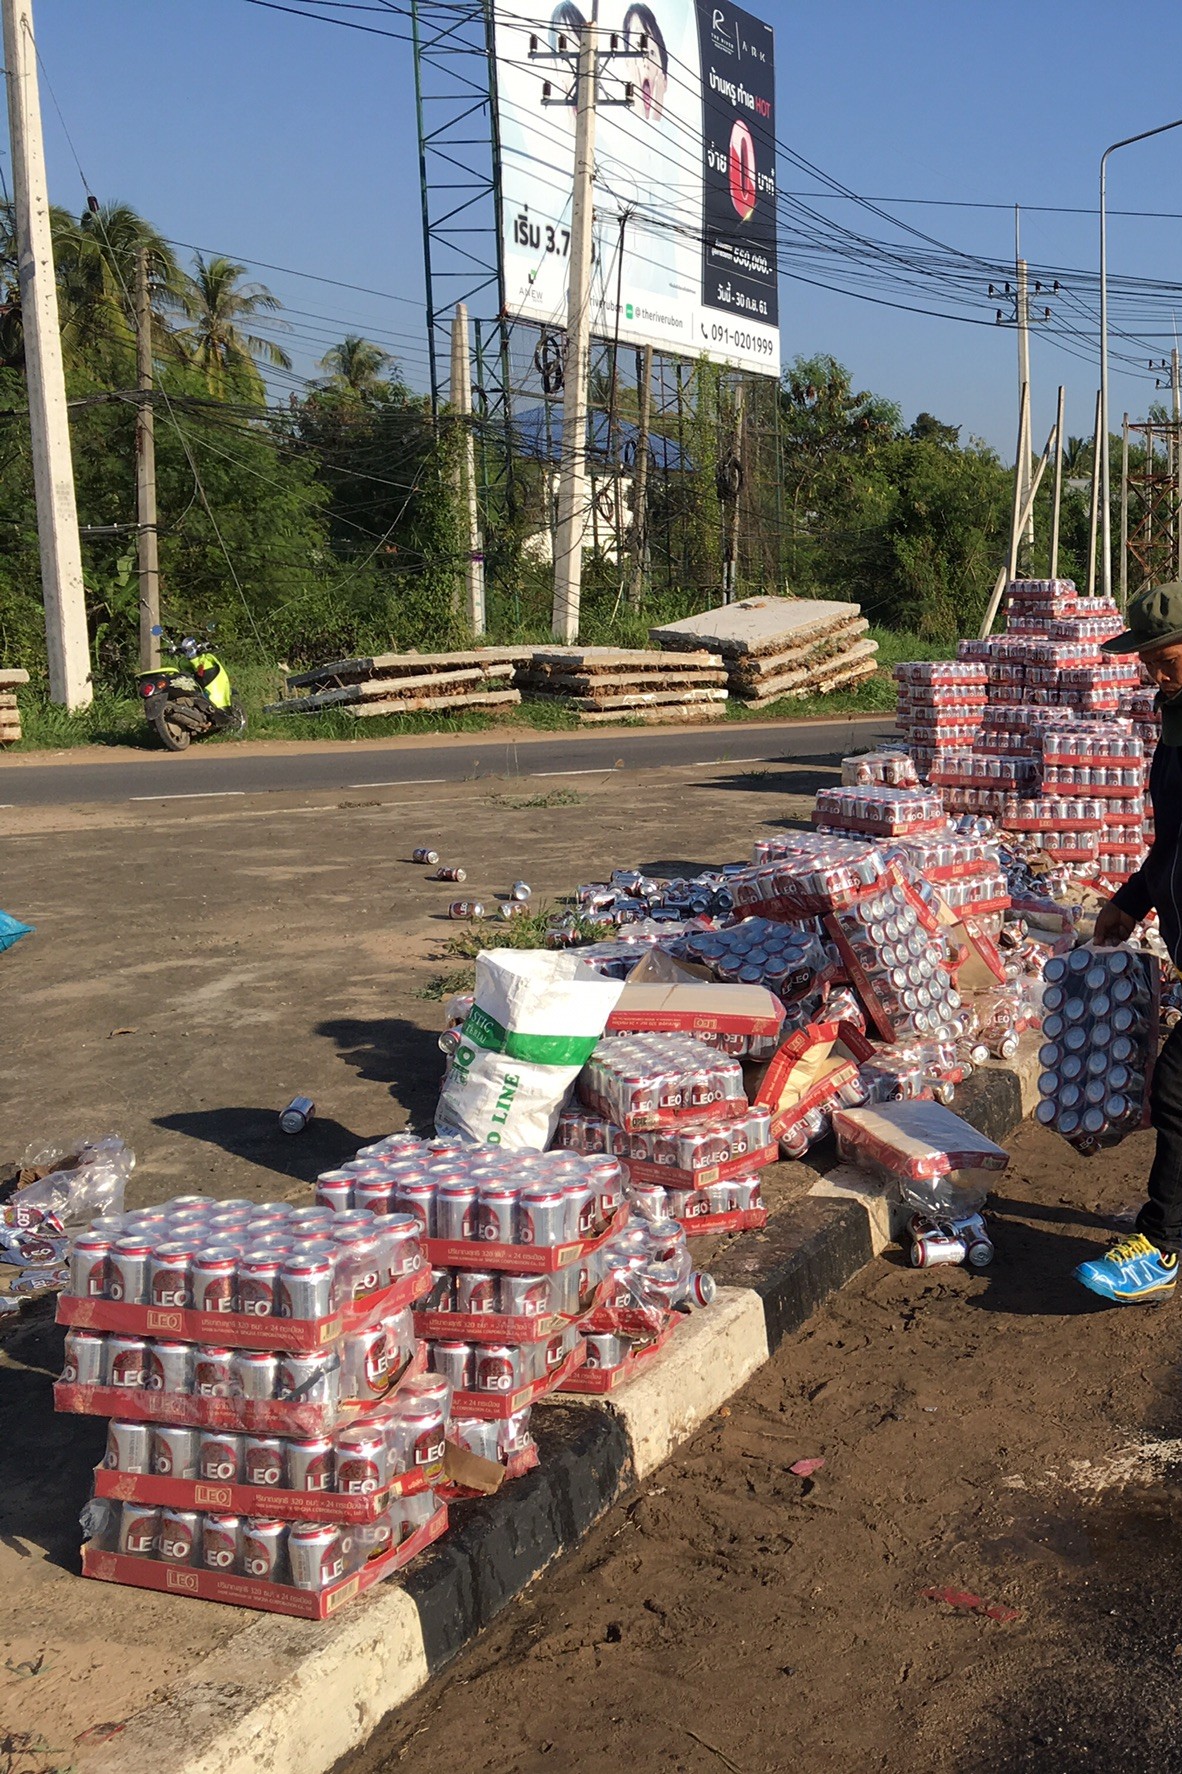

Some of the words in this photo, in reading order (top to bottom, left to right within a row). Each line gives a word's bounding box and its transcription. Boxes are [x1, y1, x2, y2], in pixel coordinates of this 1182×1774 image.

[754, 96, 771, 119] HOT
[513, 203, 541, 250] เริ่ม
[518, 286, 544, 300] ANEW
[758, 299, 769, 315] 61
[711, 323, 774, 356] 091-0201999
[993, 1013, 1010, 1024] LEO
[491, 1072, 520, 1125] LINE
[659, 1092, 681, 1107] LEO
[653, 1152, 676, 1164] LEO
[17, 1207, 30, 1227] LEO
[391, 1253, 421, 1277] LEO
[152, 1289, 192, 1308] LEO
[205, 1296, 236, 1314] LE
[471, 1297, 494, 1315] LE
[524, 1299, 547, 1316] LE
[149, 1314, 181, 1330] LEO
[270, 1324, 279, 1332] 24
[547, 1345, 563, 1364] LE
[366, 1358, 388, 1379] LE
[479, 1374, 512, 1391] LEO
[468, 1399, 477, 1407] 24
[414, 1440, 445, 1465] LEO
[200, 1461, 236, 1480] LEO
[246, 1466, 280, 1485] LEO
[306, 1471, 331, 1492] LE
[198, 1487, 229, 1505] LEO
[291, 1498, 304, 1506] 320
[326, 1500, 335, 1508] 24
[127, 1533, 153, 1552] LE
[205, 1550, 235, 1568] EO
[243, 1557, 269, 1576] EO
[168, 1571, 197, 1590] LEO
[320, 1557, 344, 1586] LE
[250, 1586, 262, 1595] 320
[281, 1592, 289, 1600] 24
